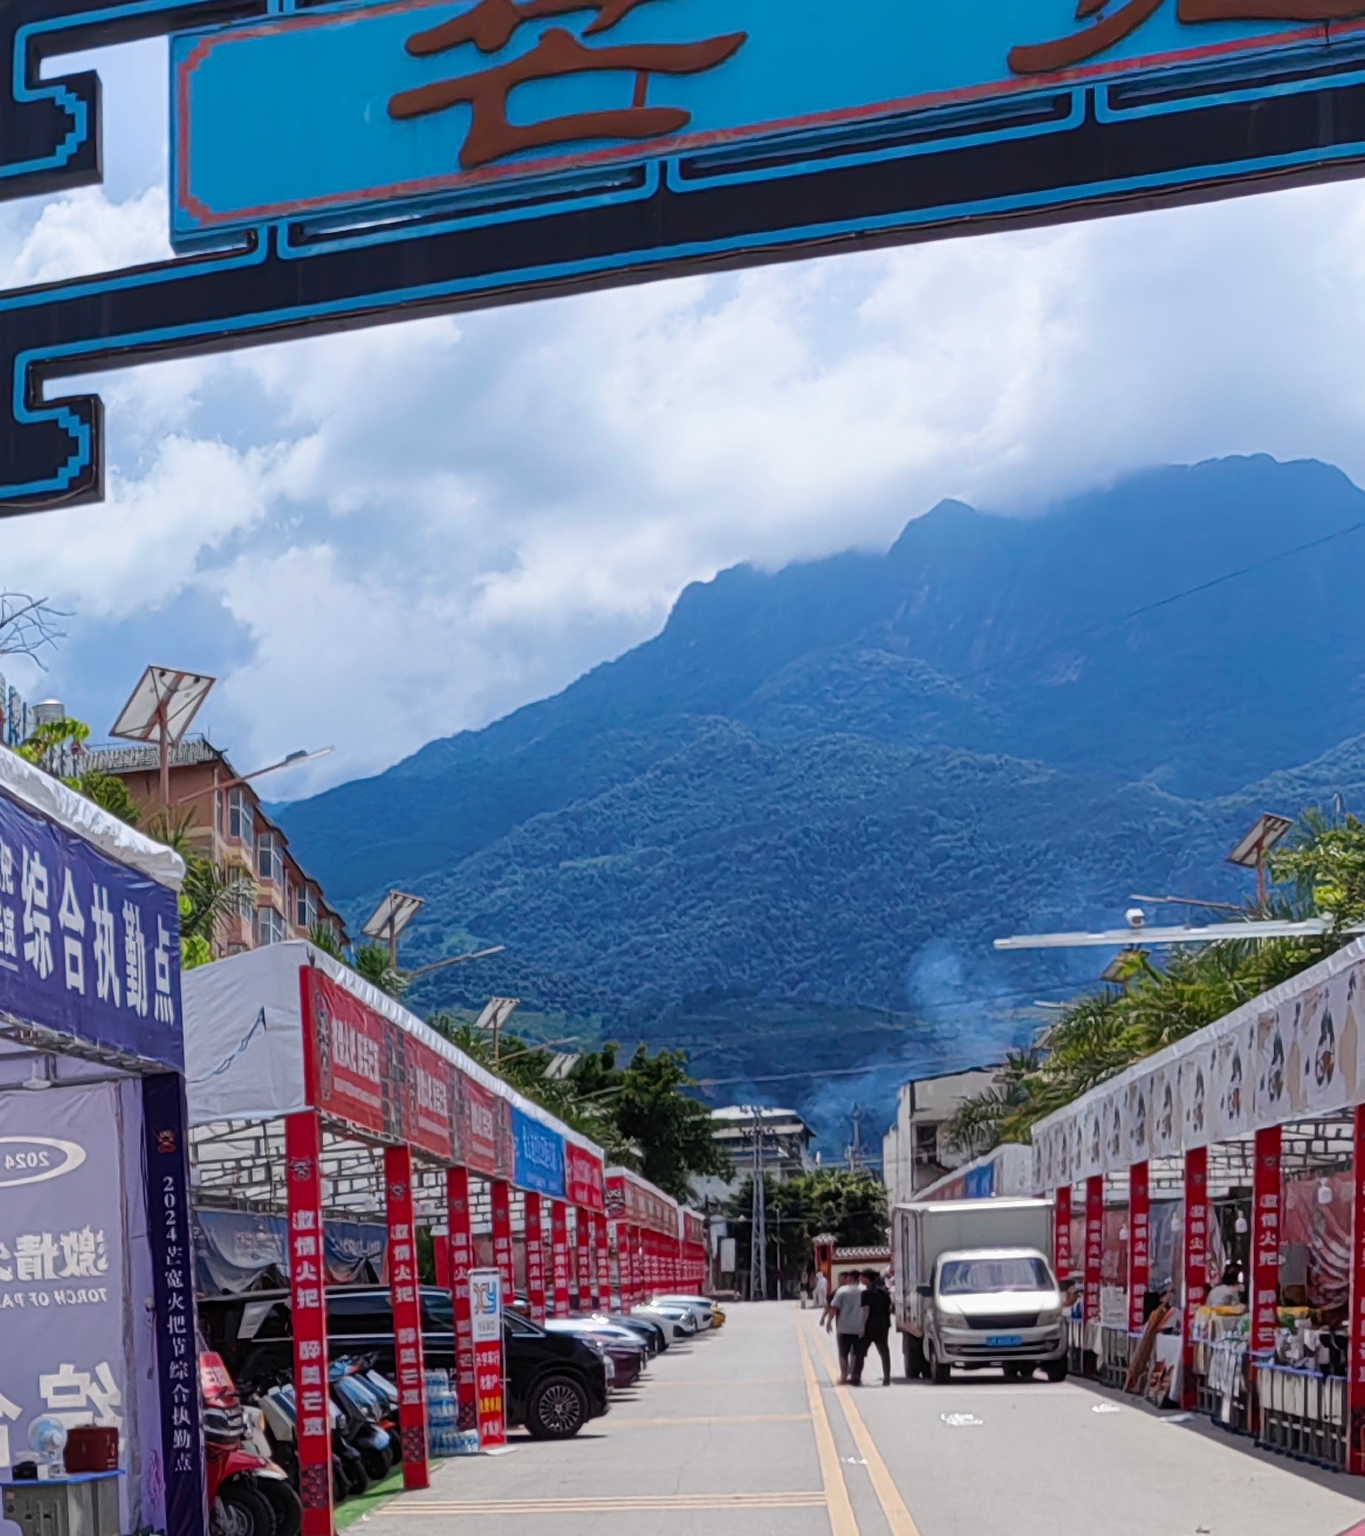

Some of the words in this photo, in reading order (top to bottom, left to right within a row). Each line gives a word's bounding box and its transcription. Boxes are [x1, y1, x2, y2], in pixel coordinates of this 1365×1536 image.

[21, 846, 174, 1026] 综合执勤点
